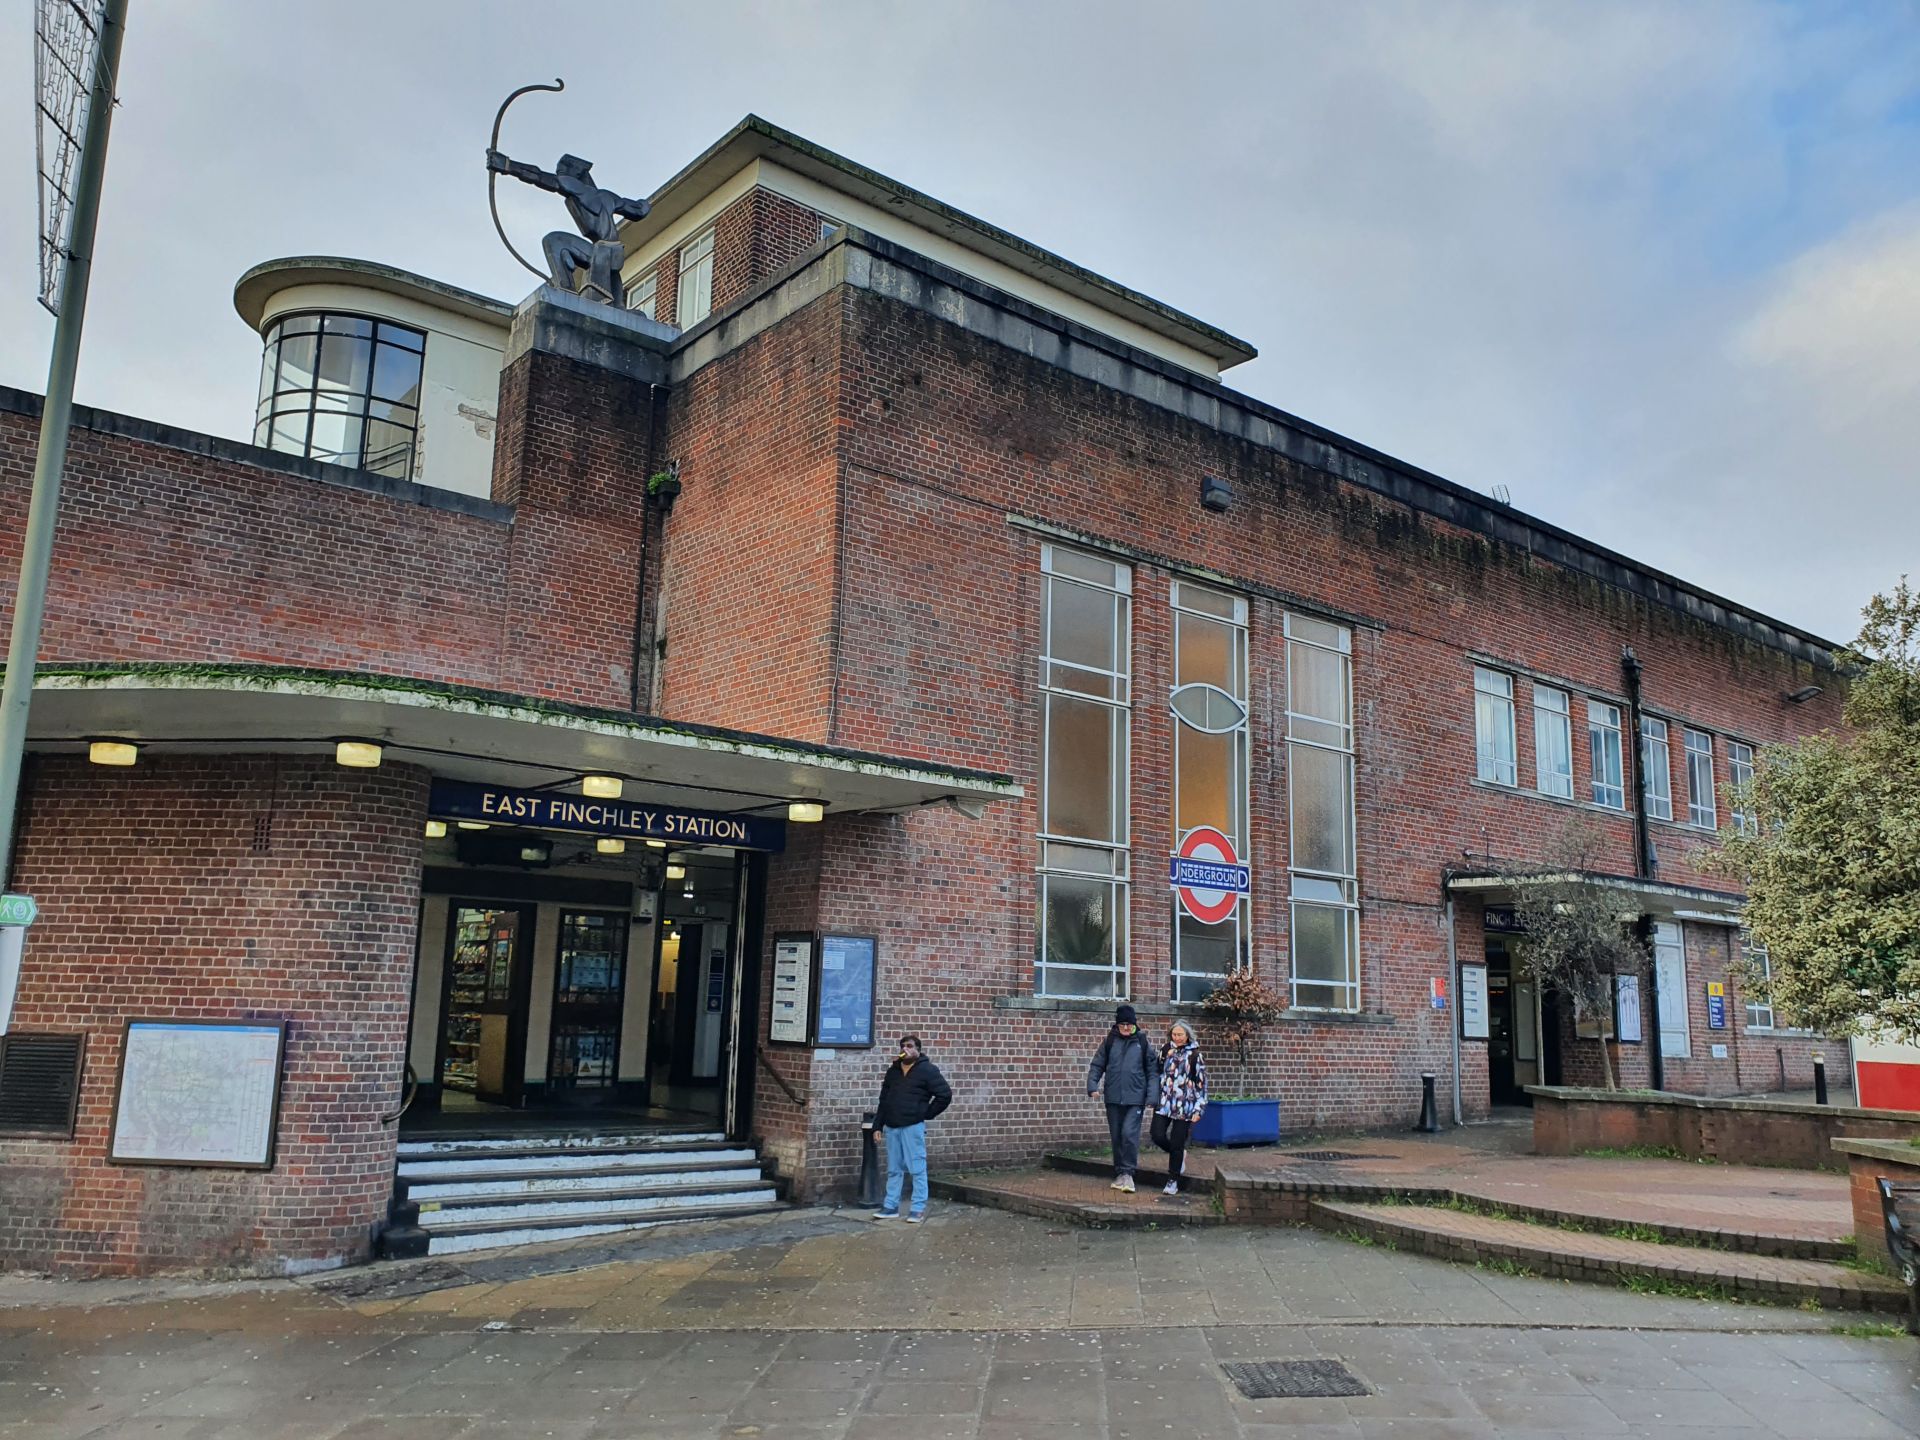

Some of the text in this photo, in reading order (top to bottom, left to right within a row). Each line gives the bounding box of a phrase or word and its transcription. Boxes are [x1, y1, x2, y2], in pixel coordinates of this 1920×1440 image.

[482, 793, 746, 840] EAST FINCHLEY STATION
[1170, 862, 1248, 888] UNDERGROUND
